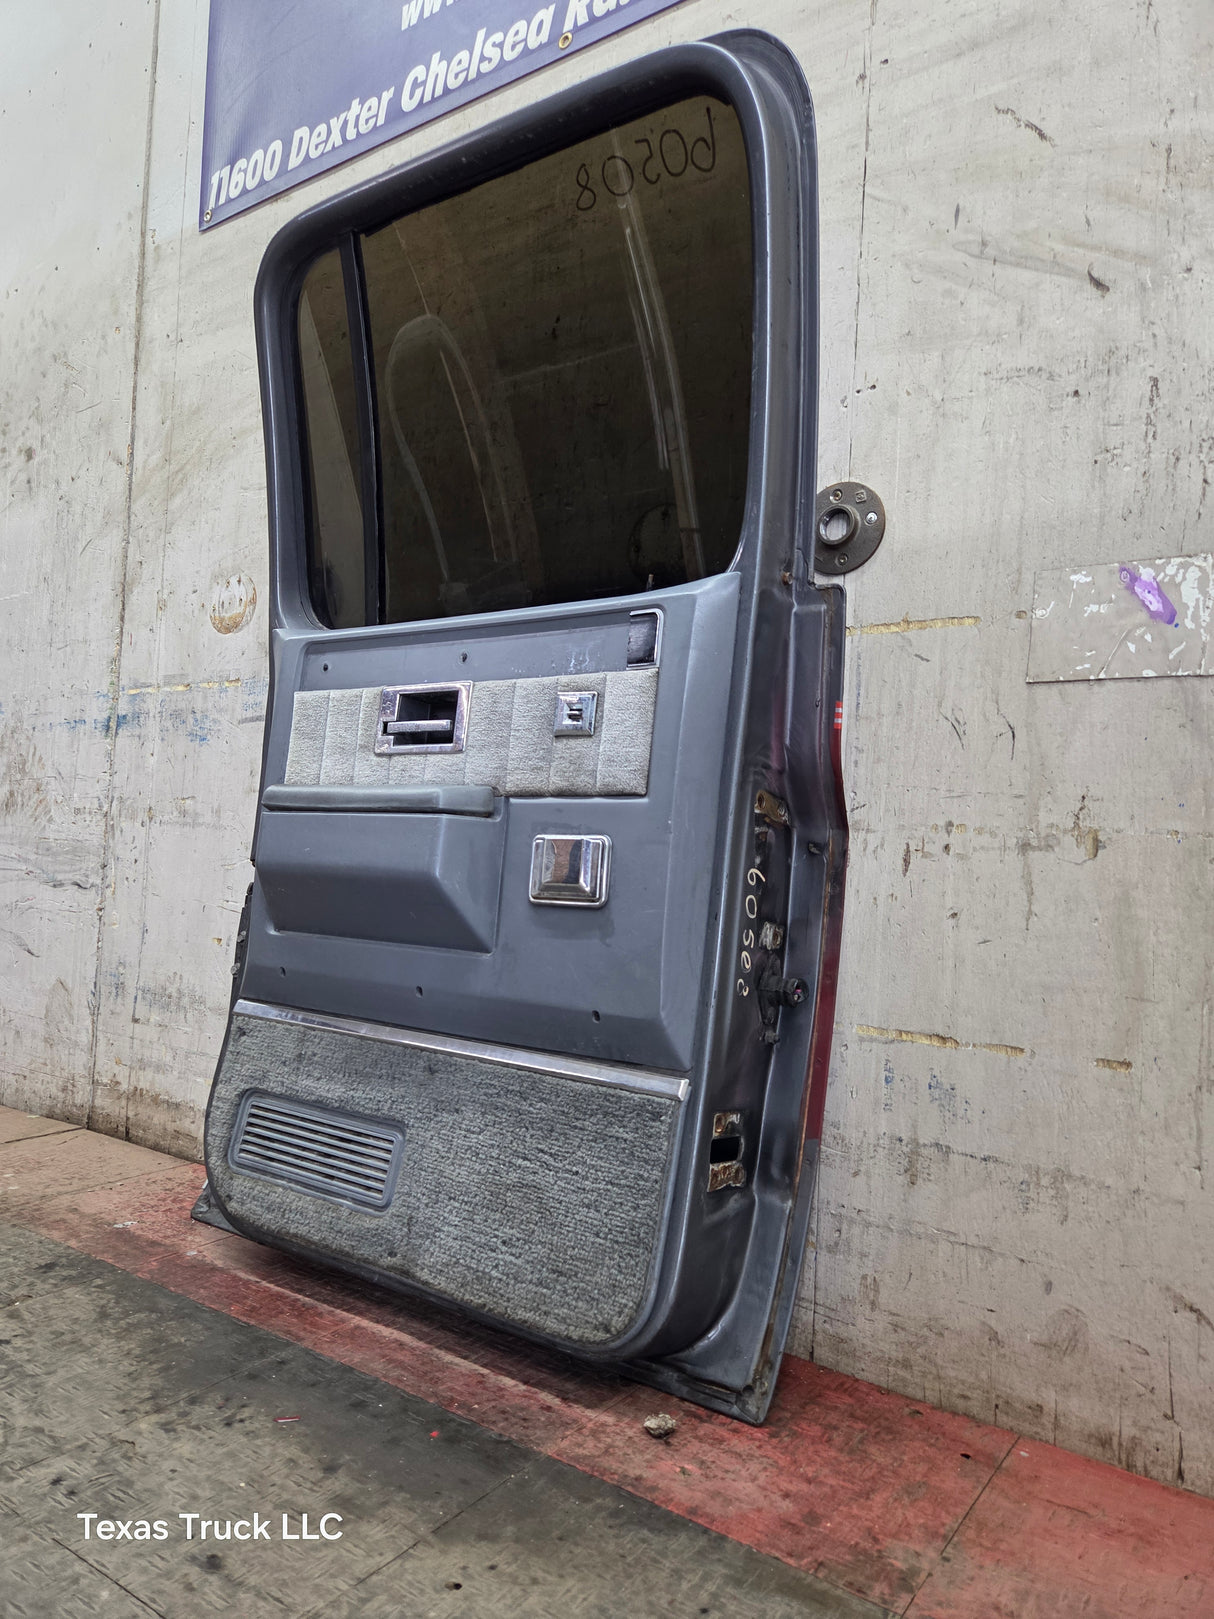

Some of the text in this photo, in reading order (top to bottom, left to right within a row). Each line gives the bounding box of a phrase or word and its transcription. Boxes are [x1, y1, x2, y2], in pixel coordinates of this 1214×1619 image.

[208, 139, 283, 210] 11600
[288, 86, 395, 171] Dexter
[401, 3, 556, 112] Chelsea
